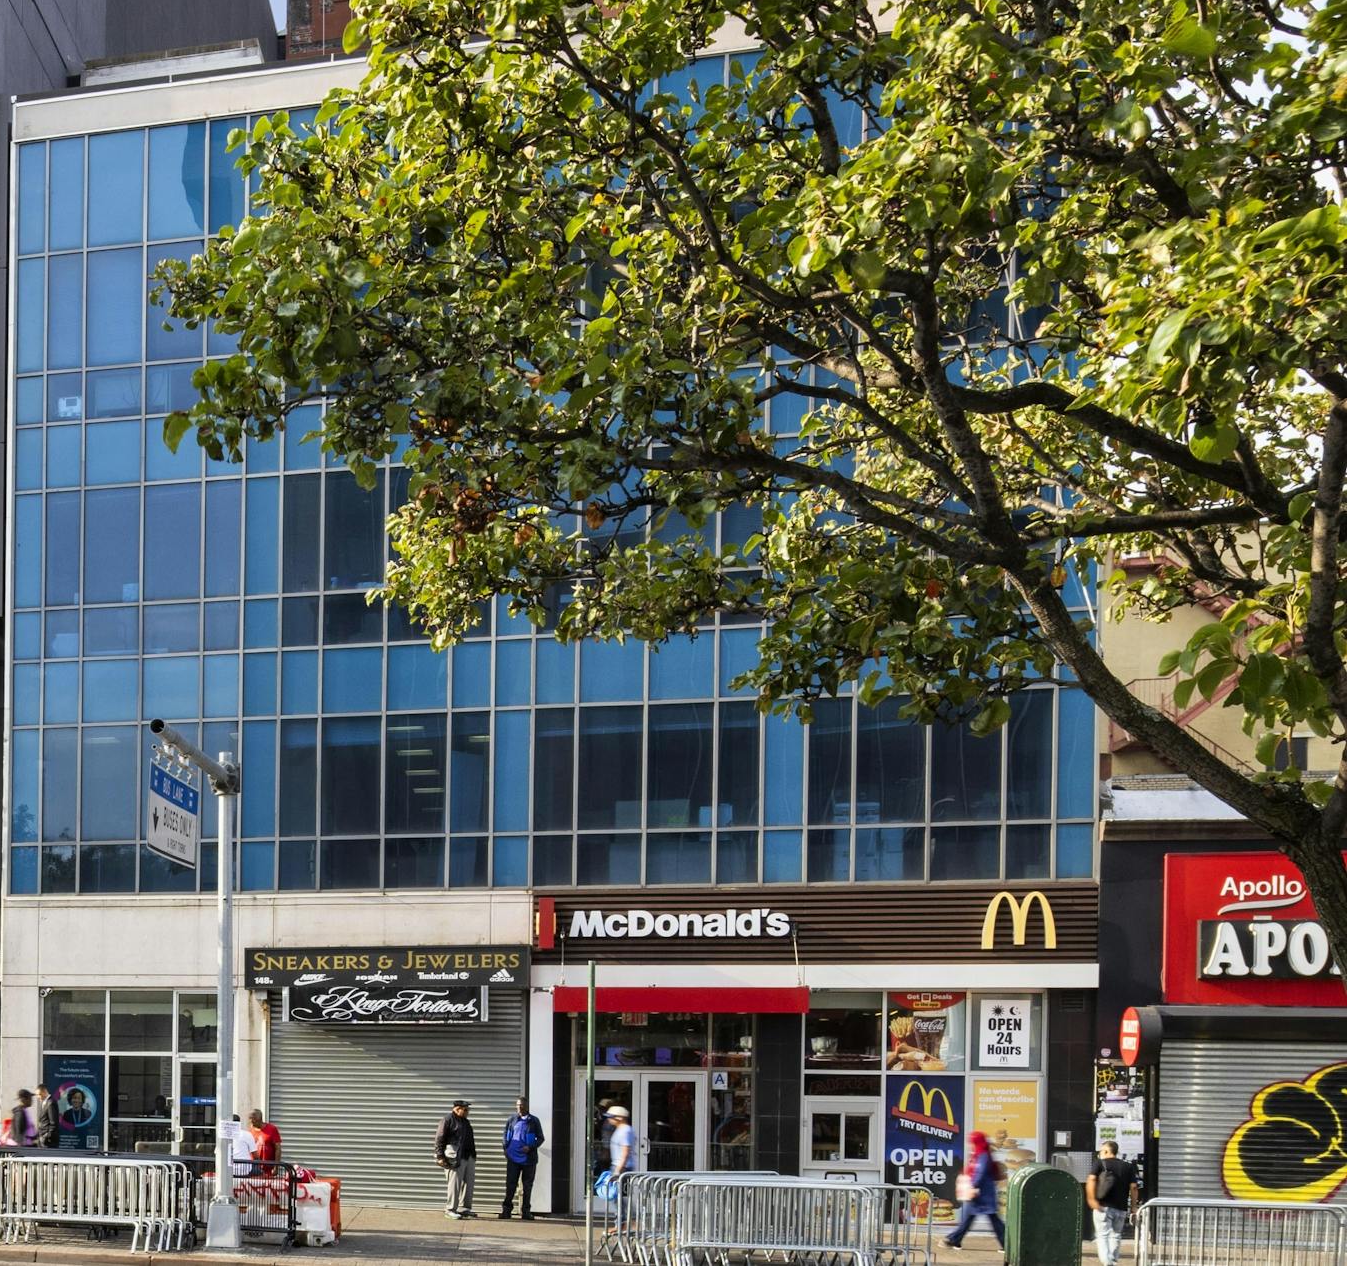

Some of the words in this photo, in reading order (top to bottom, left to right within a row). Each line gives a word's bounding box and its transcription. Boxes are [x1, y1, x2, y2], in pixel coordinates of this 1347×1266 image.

[1219, 875, 1303, 901] Apollo
[569, 908, 791, 938] McDonald's
[1203, 921, 1343, 976] APO
[253, 952, 370, 971] SNEAKERS
[377, 954, 394, 970] &
[402, 949, 520, 970] JEWELERS
[299, 973, 327, 981] NIKE
[417, 972, 458, 980] Timberland
[988, 1017, 1022, 1031] OPEN
[996, 1032, 1013, 1045] 24
[987, 1044, 1022, 1056] Hours
[714, 1073, 725, 1085] A
[979, 1087, 992, 1095] No
[996, 1094, 1035, 1103] describe
[979, 1103, 1003, 1111] them
[899, 1118, 915, 1130] TRY
[915, 1121, 953, 1140] DELIVERY
[890, 1148, 954, 1167] OPEN
[898, 1166, 947, 1185] Late
